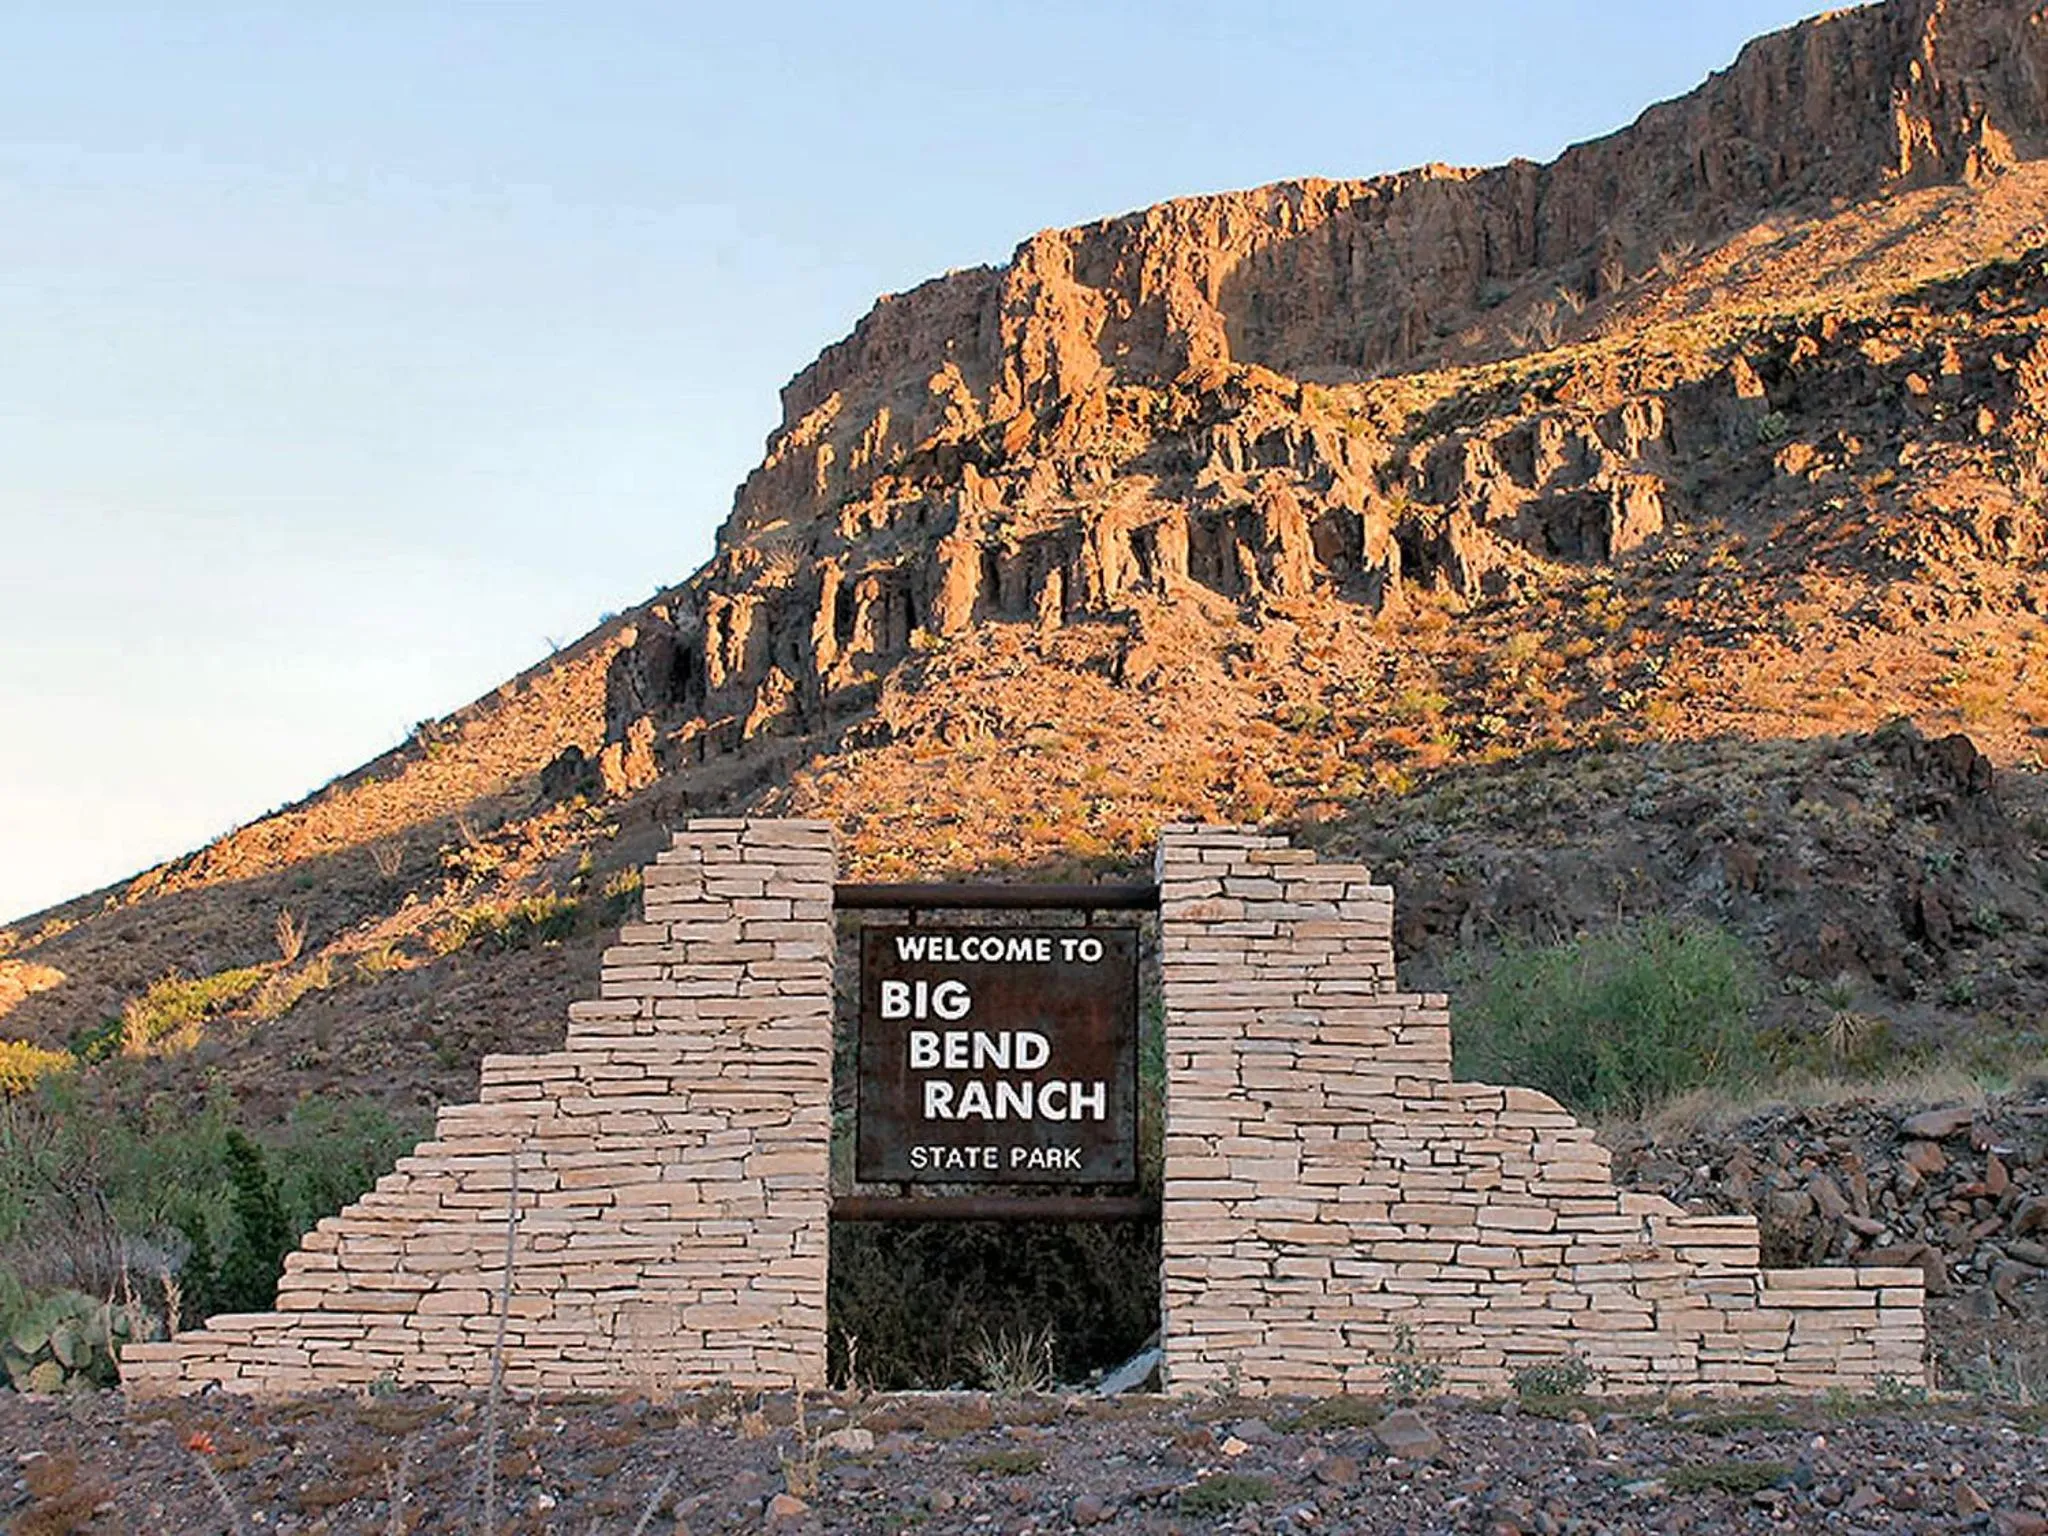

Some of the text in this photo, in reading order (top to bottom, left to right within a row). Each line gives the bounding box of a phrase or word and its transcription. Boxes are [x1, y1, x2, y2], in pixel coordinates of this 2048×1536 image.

[896, 936, 1103, 962] WELCOME TO
[881, 980, 971, 1020] BIG
[910, 1030, 1050, 1070] BEND
[924, 1080, 1106, 1121] RANCH
[910, 1146, 1082, 1169] STATE PARK
